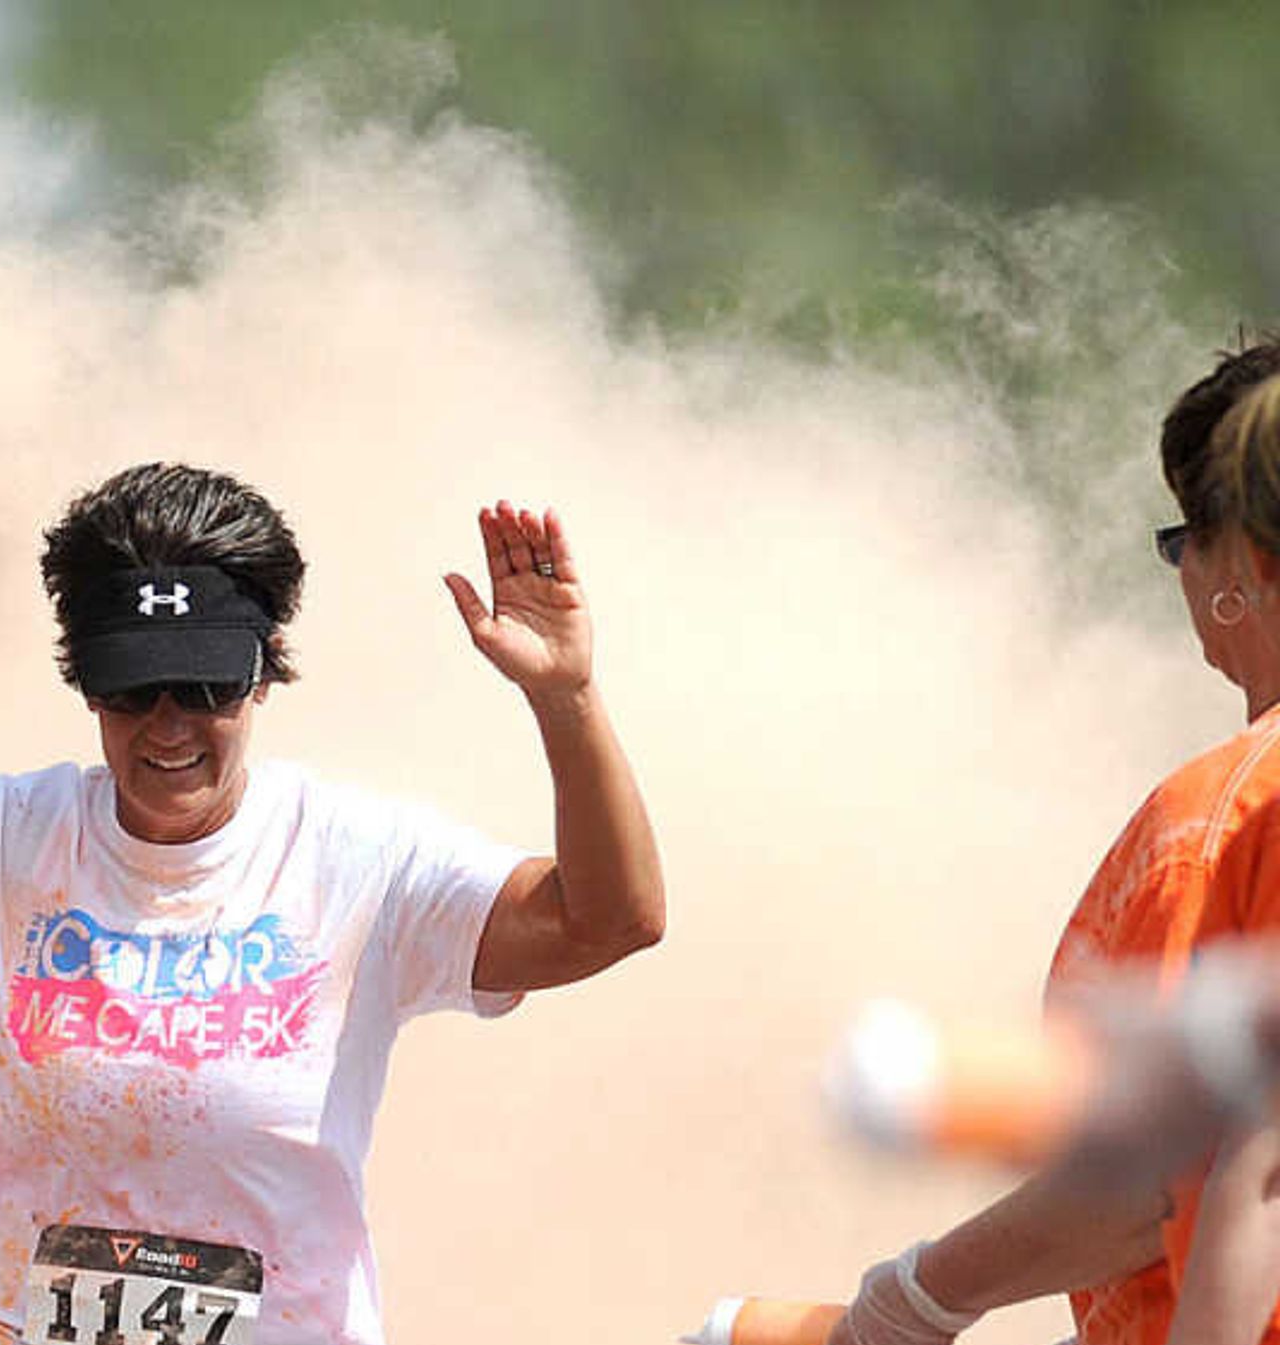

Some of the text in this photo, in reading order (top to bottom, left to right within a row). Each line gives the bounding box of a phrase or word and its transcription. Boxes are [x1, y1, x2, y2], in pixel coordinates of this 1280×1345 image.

[42, 917, 274, 1000] COLOR
[20, 991, 306, 1051] ME CAPE 5K
